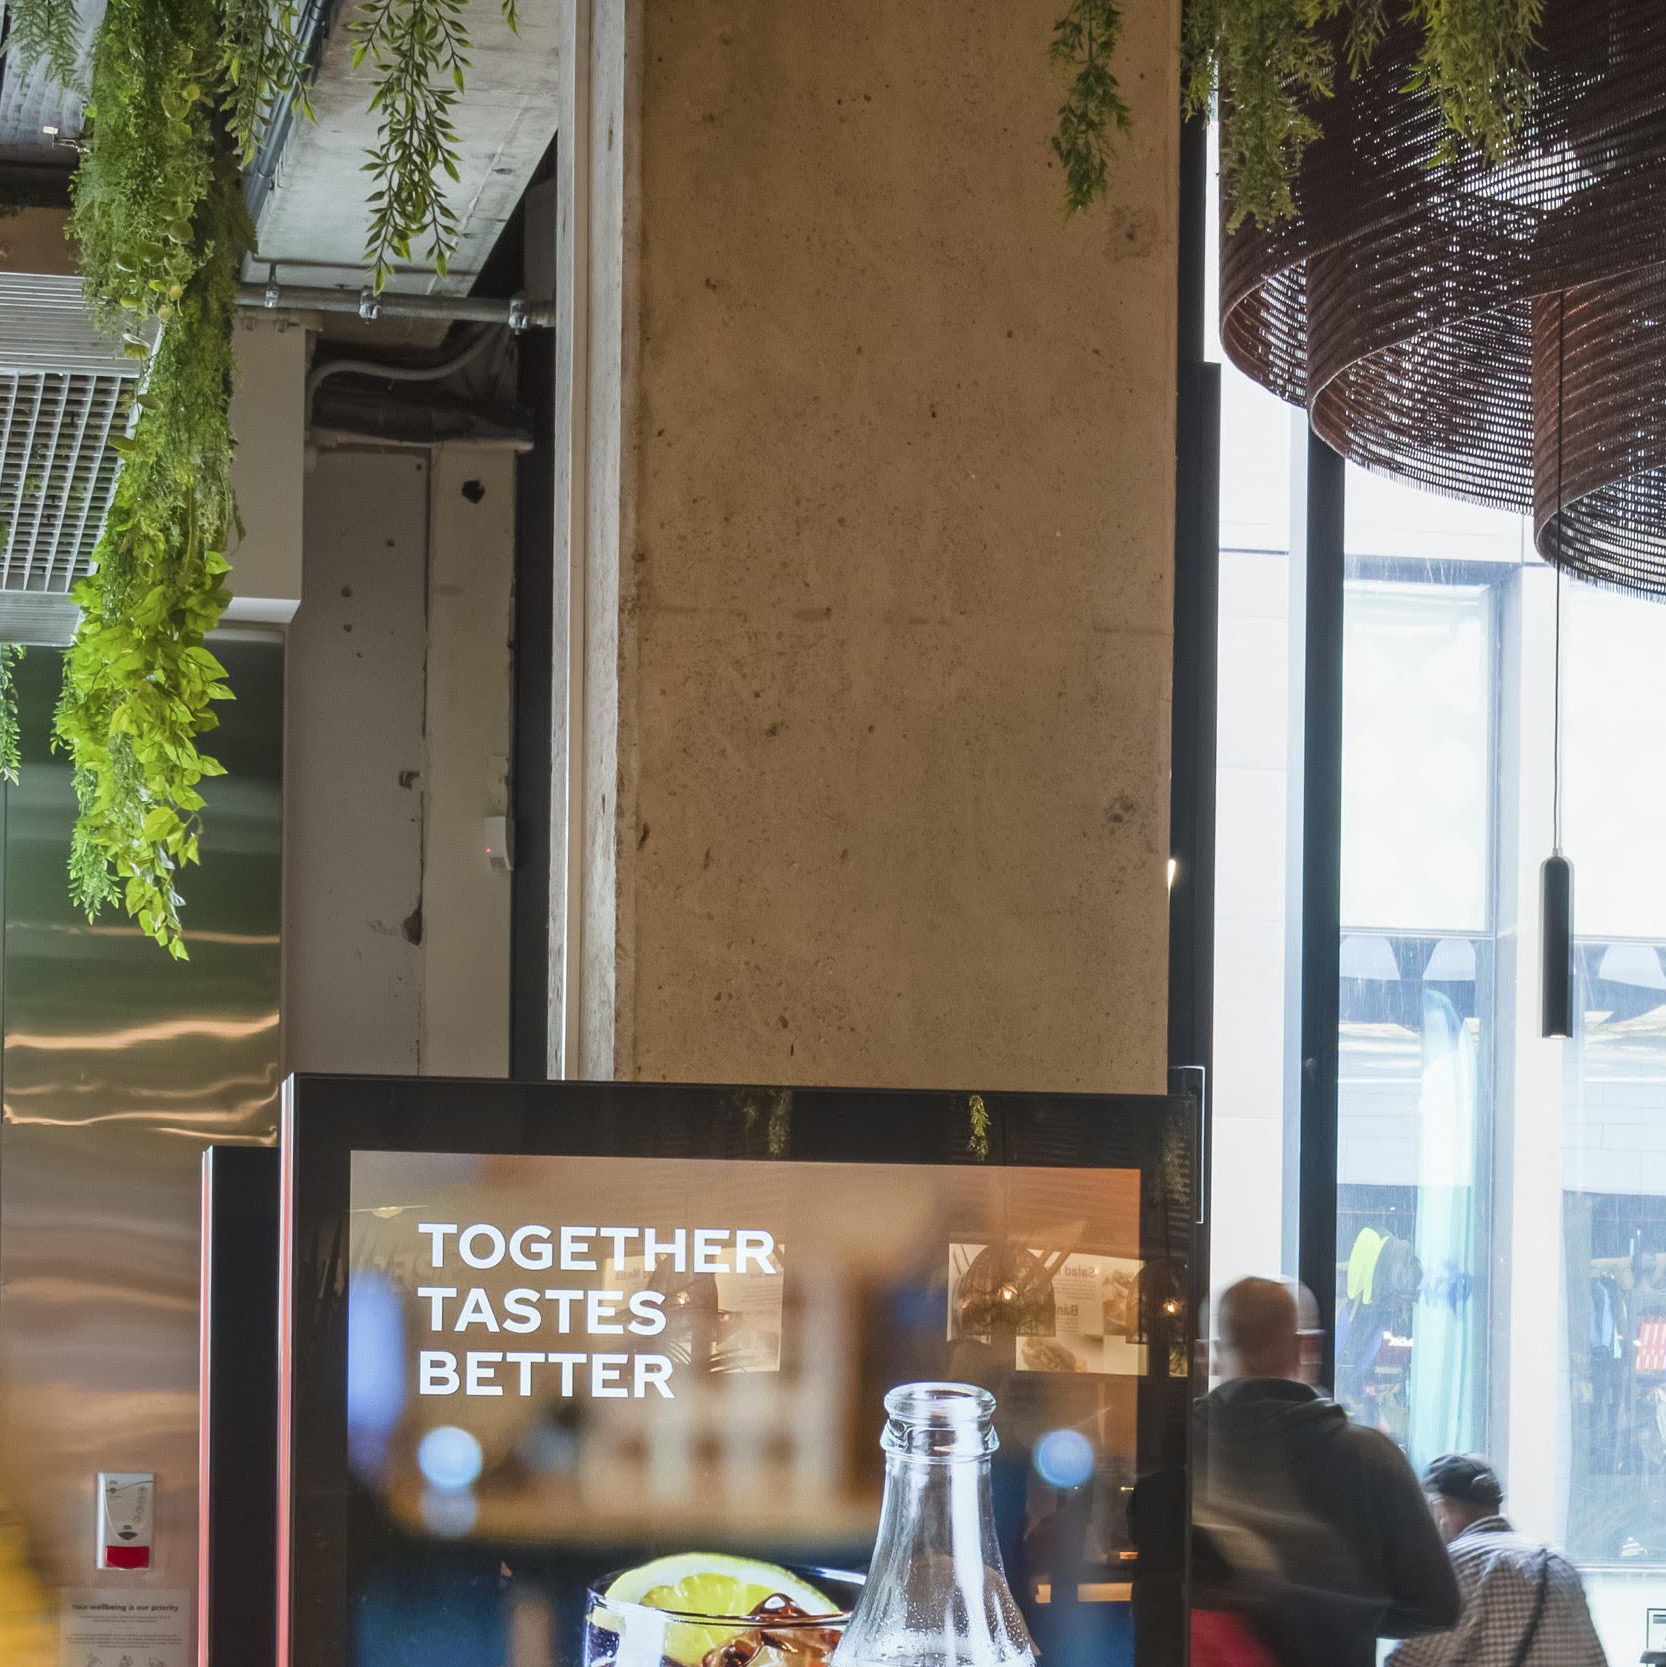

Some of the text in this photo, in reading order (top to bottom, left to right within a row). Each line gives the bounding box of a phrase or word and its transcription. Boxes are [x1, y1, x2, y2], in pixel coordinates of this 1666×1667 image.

[417, 1221, 777, 1275] TOGETHER
[417, 1286, 668, 1337] TASTES
[418, 1349, 676, 1400] BETTER
